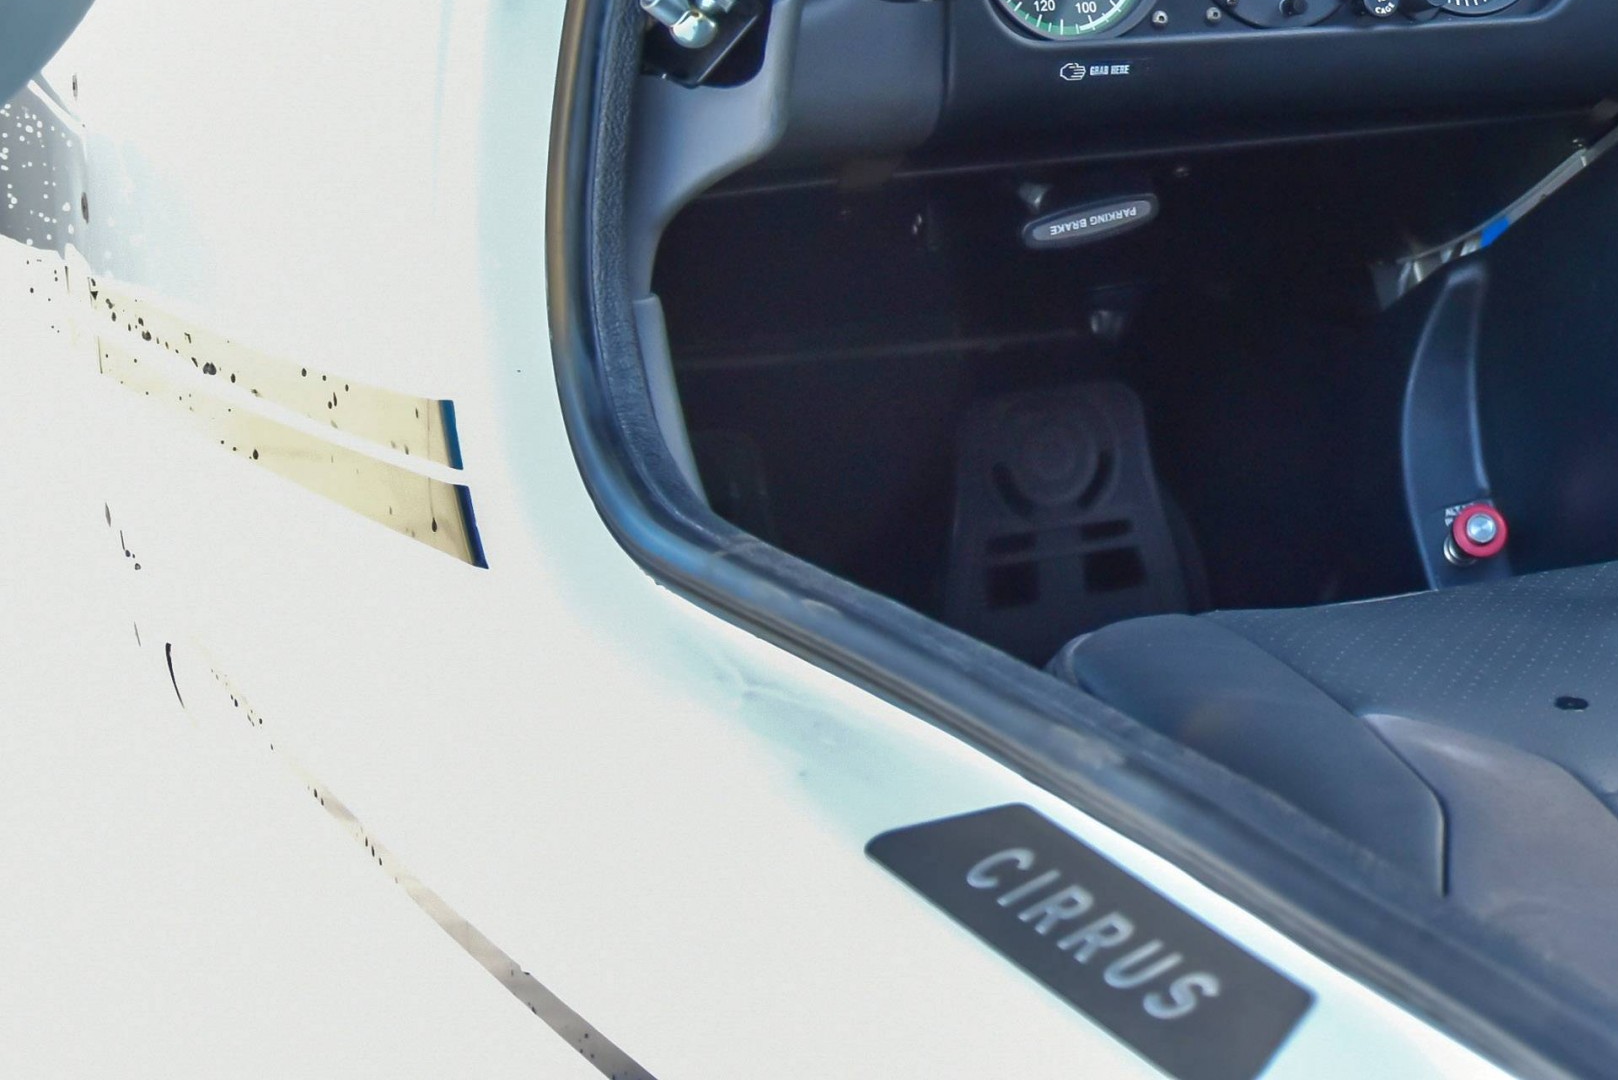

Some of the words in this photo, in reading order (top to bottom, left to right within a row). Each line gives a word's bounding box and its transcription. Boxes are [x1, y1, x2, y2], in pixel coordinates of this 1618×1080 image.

[1034, 0, 1055, 11] 120
[1075, 2, 1097, 13] 100
[1375, 2, 1395, 14] CAGE
[1089, 207, 1136, 225] PARKING
[1050, 218, 1087, 235] BRAKE
[966, 847, 1220, 1020] CIRRUS
